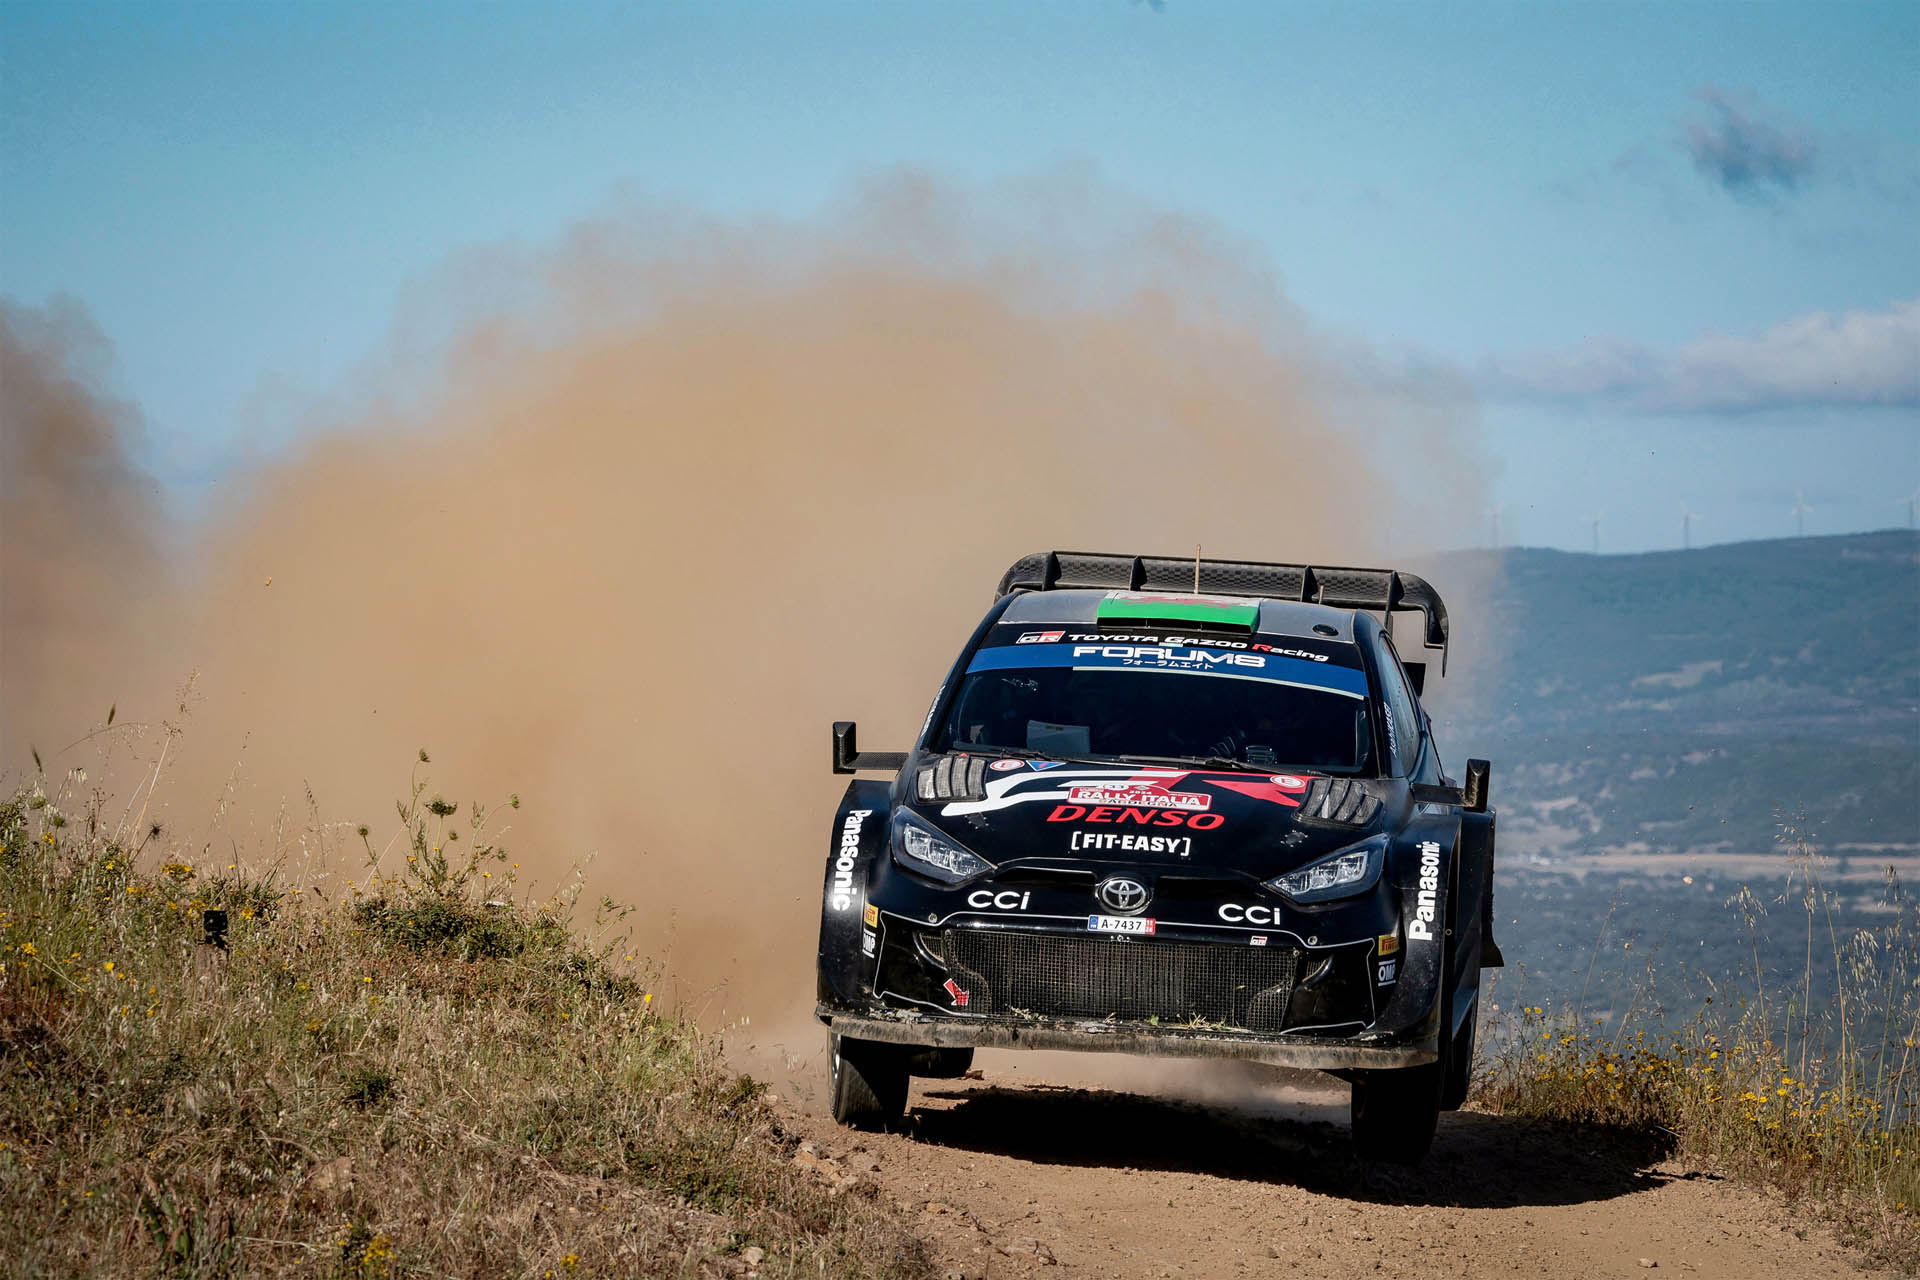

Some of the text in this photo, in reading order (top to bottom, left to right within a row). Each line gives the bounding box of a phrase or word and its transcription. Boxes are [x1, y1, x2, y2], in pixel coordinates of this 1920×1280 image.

[1018, 632, 1062, 644] GR
[1068, 633, 1329, 662] TOYOTA GAZOO Racing
[1073, 645, 1266, 668] FORUM8
[1122, 658, 1214, 671] フォーラムエイト
[1077, 790, 1136, 802] RALLY
[1141, 794, 1201, 806] ITALIA
[1046, 804, 1225, 830] DENSO
[832, 809, 873, 911] Panasonic
[1408, 841, 1441, 941] Panasonic
[1101, 919, 1142, 931] A-7437
